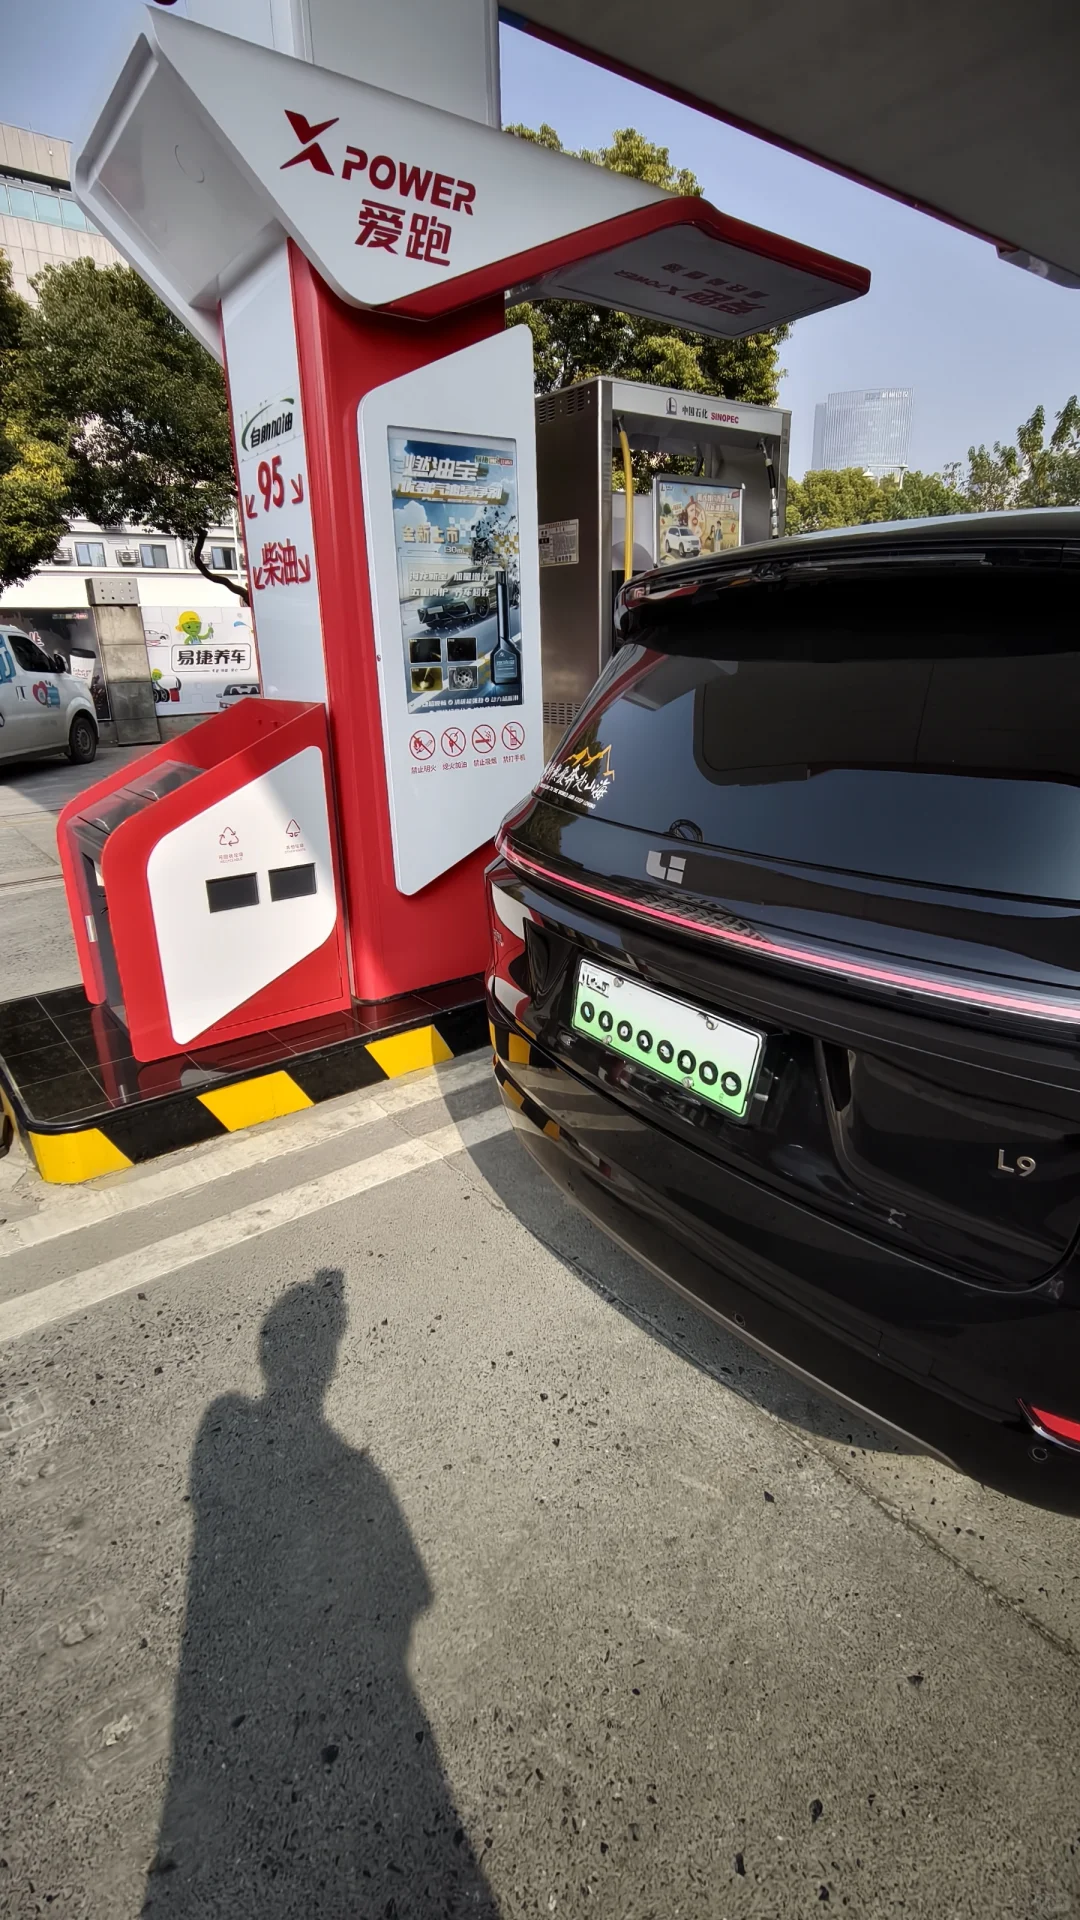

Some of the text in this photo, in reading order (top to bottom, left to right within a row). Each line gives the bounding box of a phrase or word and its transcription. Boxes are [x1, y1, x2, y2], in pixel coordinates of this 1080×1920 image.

[342, 145, 477, 216] POWER
[355, 198, 452, 267] 爱跑
[682, 405, 739, 424] 中国石化 SINOPEC
[250, 411, 293, 448] 自助加油
[402, 453, 479, 482] 燃油宝
[258, 455, 285, 513] 95
[402, 524, 459, 544] 全新上市
[261, 538, 299, 586] 柴油
[177, 649, 246, 666] 易捷养车
[411, 764, 437, 774] 禁止明火
[442, 760, 468, 771] 熄火加油
[473, 757, 498, 767] 禁止吸烟
[503, 753, 526, 764] 禁打手机
[997, 1148, 1036, 1177] L9
